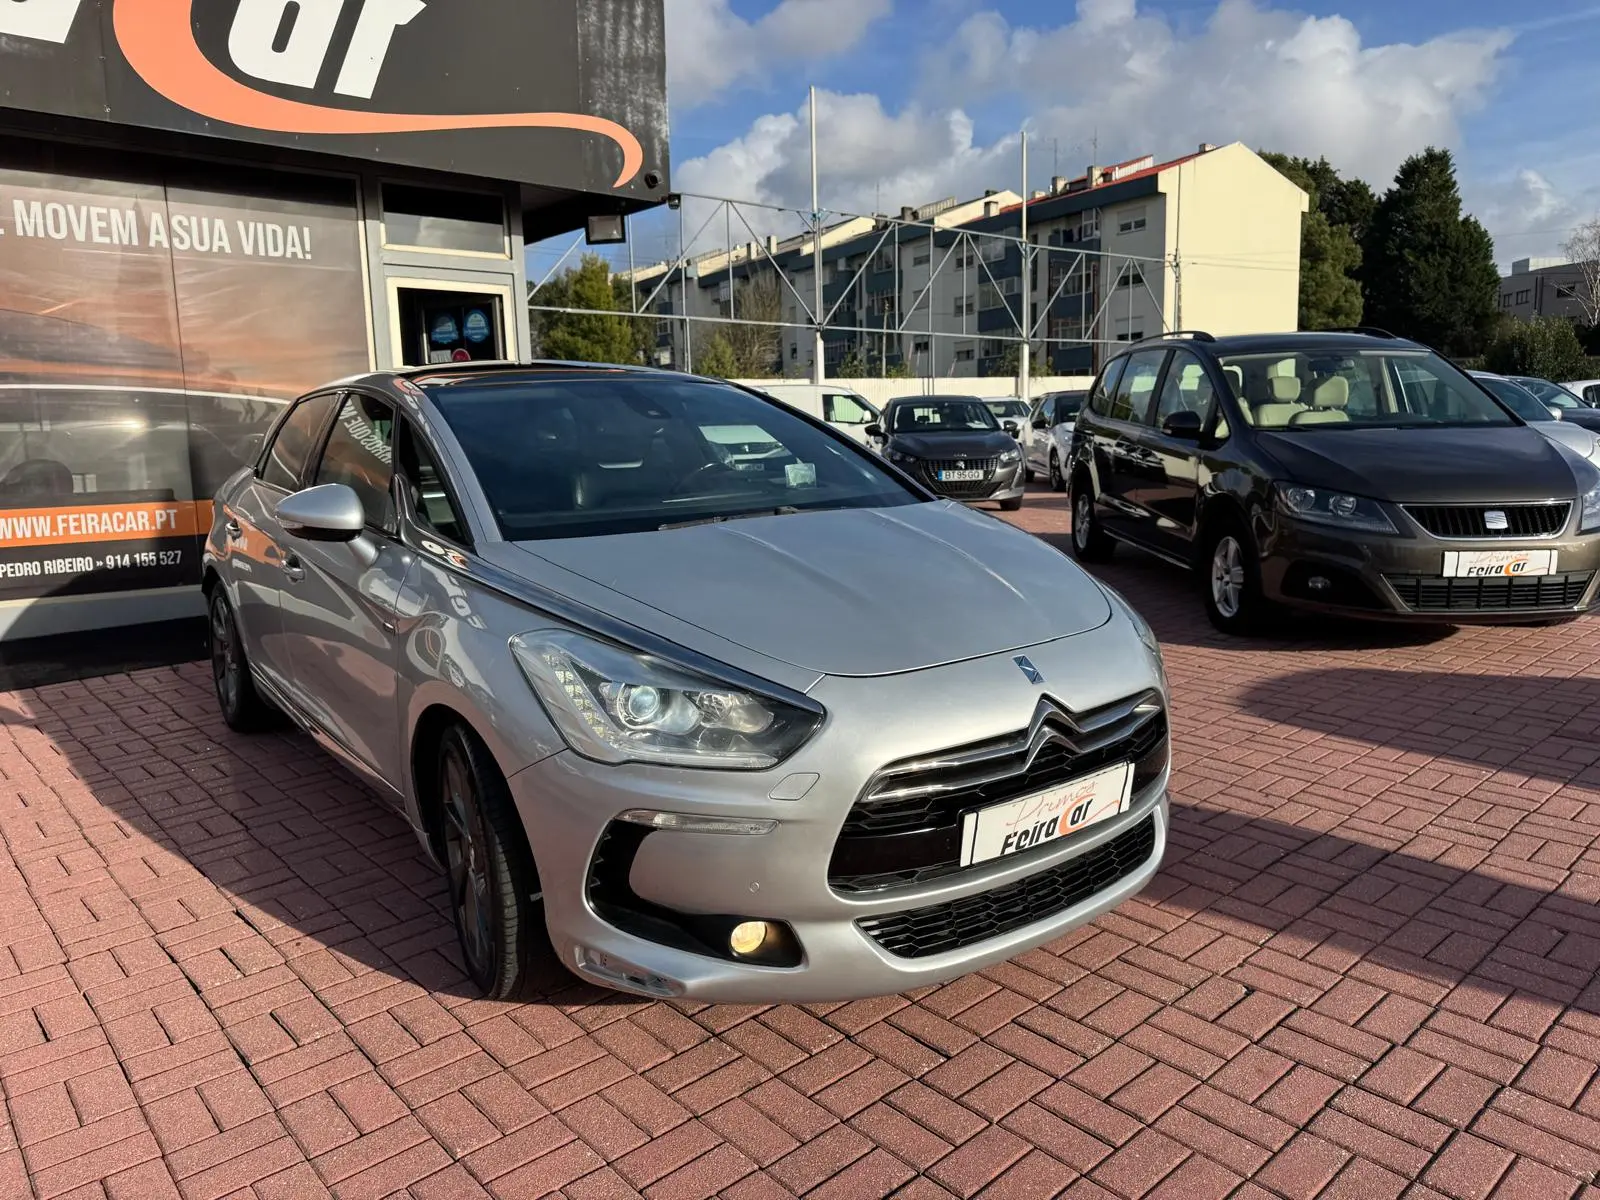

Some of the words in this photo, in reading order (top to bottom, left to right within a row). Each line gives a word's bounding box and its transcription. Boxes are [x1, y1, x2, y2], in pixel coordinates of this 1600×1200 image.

[13, 199, 139, 246] MOVEM
[236, 219, 312, 260] VIDA!
[0, 509, 178, 541] WWW.FEIRACAR.PT
[0, 561, 42, 579] PEDRO
[44, 556, 94, 575] RIBEIRO
[105, 554, 131, 570] 914
[134, 551, 157, 567] 155
[160, 549, 182, 565] 527
